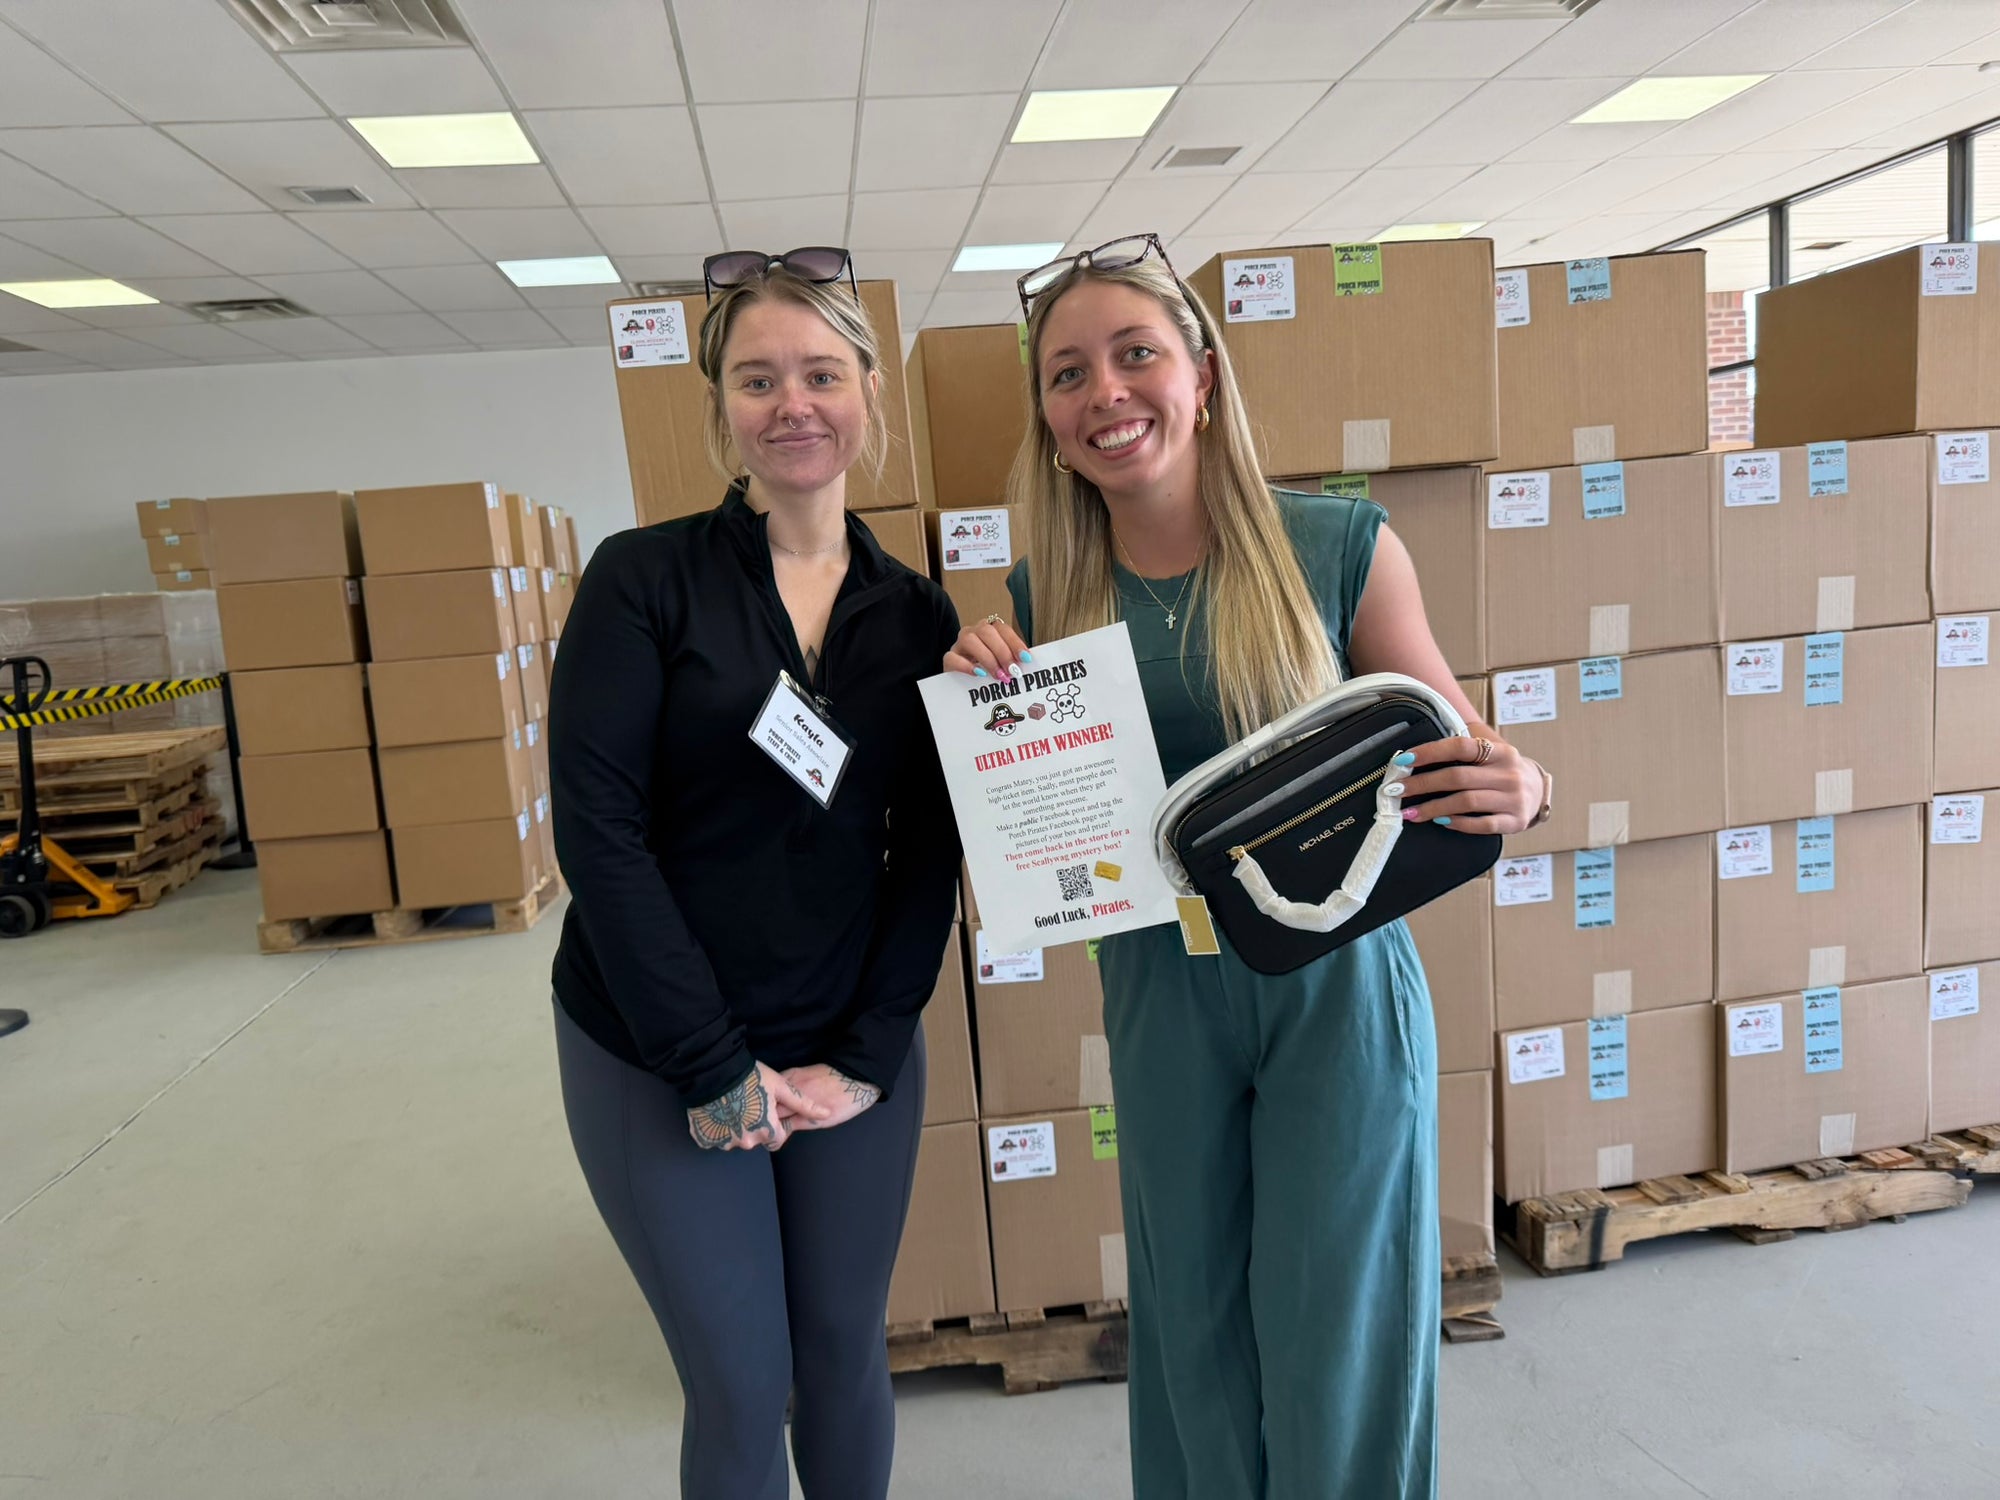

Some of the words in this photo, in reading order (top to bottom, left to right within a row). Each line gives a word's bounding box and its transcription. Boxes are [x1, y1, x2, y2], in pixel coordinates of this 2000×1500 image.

[968, 678, 1021, 707] PORCH
[1022, 659, 1087, 692] PIRATES
[794, 714, 824, 748] Kayla
[975, 748, 1015, 772] ULTRA
[1017, 738, 1051, 761] ITEM
[1054, 722, 1114, 751] WINNER!
[986, 784, 1012, 794] Congrats
[1013, 779, 1034, 787] Matey,
[1049, 771, 1061, 780] just
[1062, 769, 1073, 777] got
[1084, 759, 1114, 770] awesome
[988, 792, 1019, 804] high-ticket
[1021, 789, 1036, 798] item.
[1038, 782, 1058, 792] Sadly,
[1059, 778, 1074, 786] most
[1076, 772, 1098, 783] people
[1022, 798, 1040, 806] world
[1041, 793, 1062, 801] know
[1061, 788, 1078, 798] when
[1080, 784, 1093, 794] they
[1095, 781, 1106, 789] get
[1023, 803, 1054, 816] something
[1056, 796, 1088, 808] awesome.
[996, 824, 1013, 832] Make
[1040, 810, 1070, 822] Facebook
[1072, 807, 1086, 816] post
[1087, 803, 1099, 811] and
[1100, 801, 1111, 809] tag
[1009, 831, 1026, 839] Porch
[1028, 826, 1048, 835] Pirates
[1049, 818, 1080, 830] Facebook
[1082, 814, 1097, 823] page
[1098, 810, 1114, 818] with
[1005, 853, 1023, 862] Then
[1025, 849, 1044, 858] come
[1045, 843, 1064, 853] back
[1075, 838, 1087, 846] the
[1088, 833, 1108, 842] store
[1110, 829, 1123, 838] for
[1016, 839, 1039, 849] pictures
[1048, 833, 1064, 841] your
[1065, 829, 1077, 837] box
[1078, 826, 1090, 834] and
[1092, 821, 1111, 832] prize!
[1299, 829, 1334, 852] MICHAEL
[1334, 816, 1355, 832] KORS
[1016, 863, 1030, 871] free
[1032, 854, 1069, 868] Scallywag
[1071, 847, 1102, 859] mystery
[1104, 841, 1122, 851] box!
[1034, 912, 1061, 928] Good
[1062, 907, 1090, 923] Luck,
[1092, 899, 1134, 917] Pirates.
